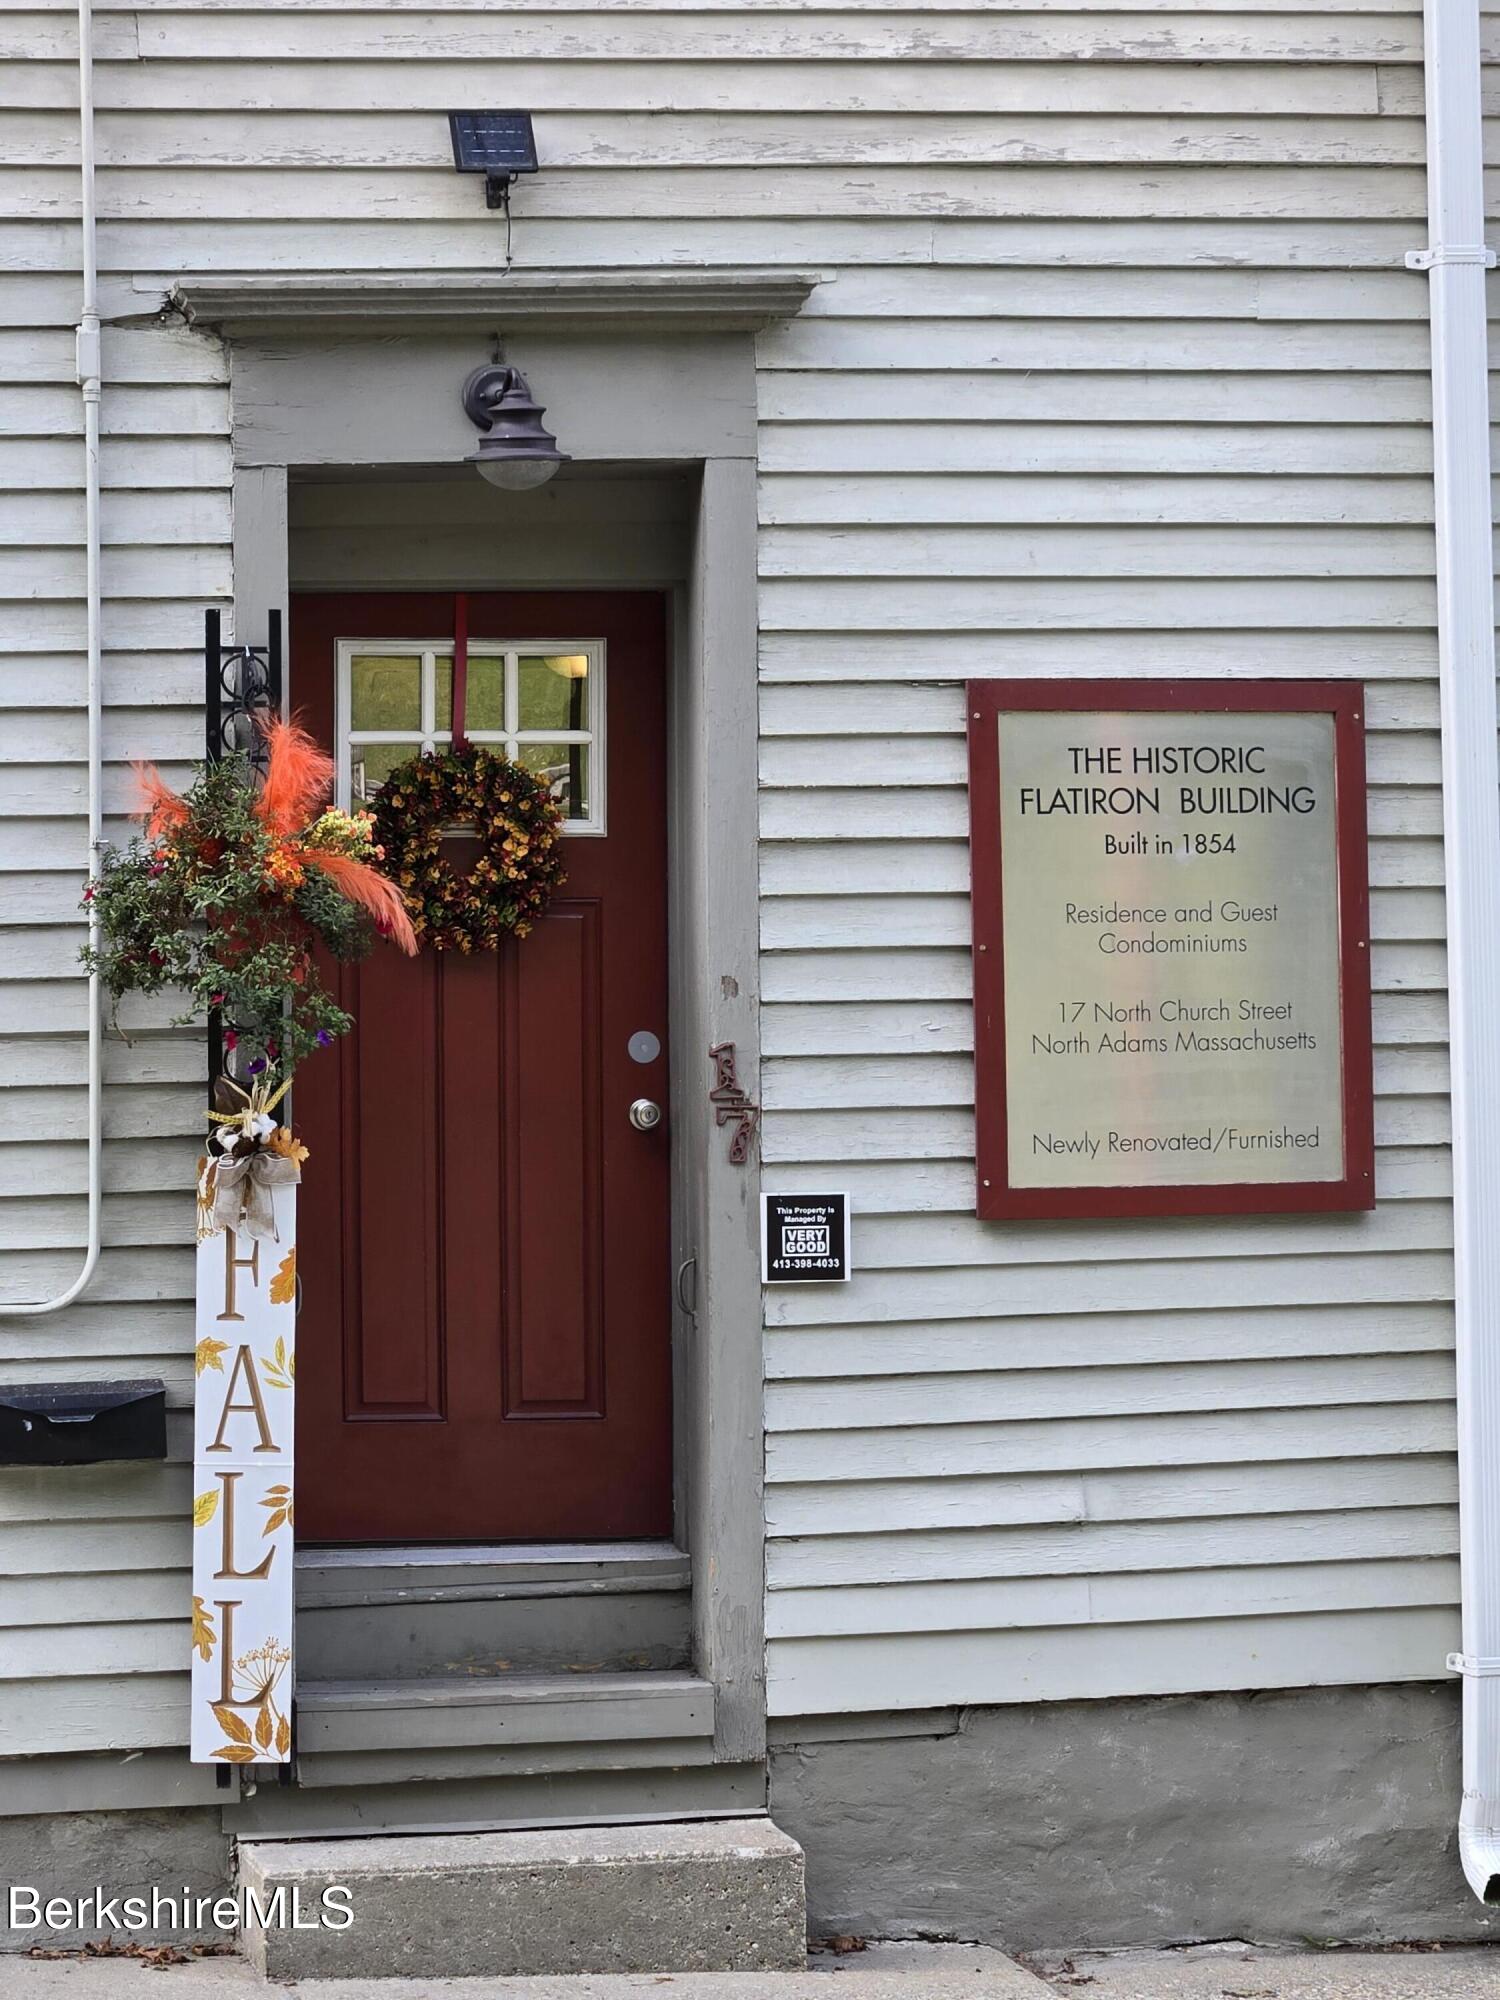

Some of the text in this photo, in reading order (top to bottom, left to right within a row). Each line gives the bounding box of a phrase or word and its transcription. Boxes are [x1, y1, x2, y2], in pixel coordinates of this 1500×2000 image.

[1068, 746, 1265, 774] THE HISTORIC
[1020, 786, 1316, 815] FLATIRON BUILDING
[1105, 832, 1236, 855] Built in 1854
[1066, 900, 1278, 923] Residence and Guest
[1099, 932, 1247, 954] Condominiums
[1059, 999, 1293, 1023] 17 North Church Street
[1032, 1028, 1317, 1054] North Adams Massachusetts
[709, 1041, 760, 1164] 17
[1033, 1126, 1319, 1160] Newly Renovated/Furnished
[776, 1207, 793, 1215] This
[794, 1207, 826, 1215] Property
[784, 1215, 827, 1223] Managed By
[787, 1229, 825, 1241] VERY
[786, 1241, 826, 1253] GOOD
[772, 1258, 840, 1269] 413-398-4033
